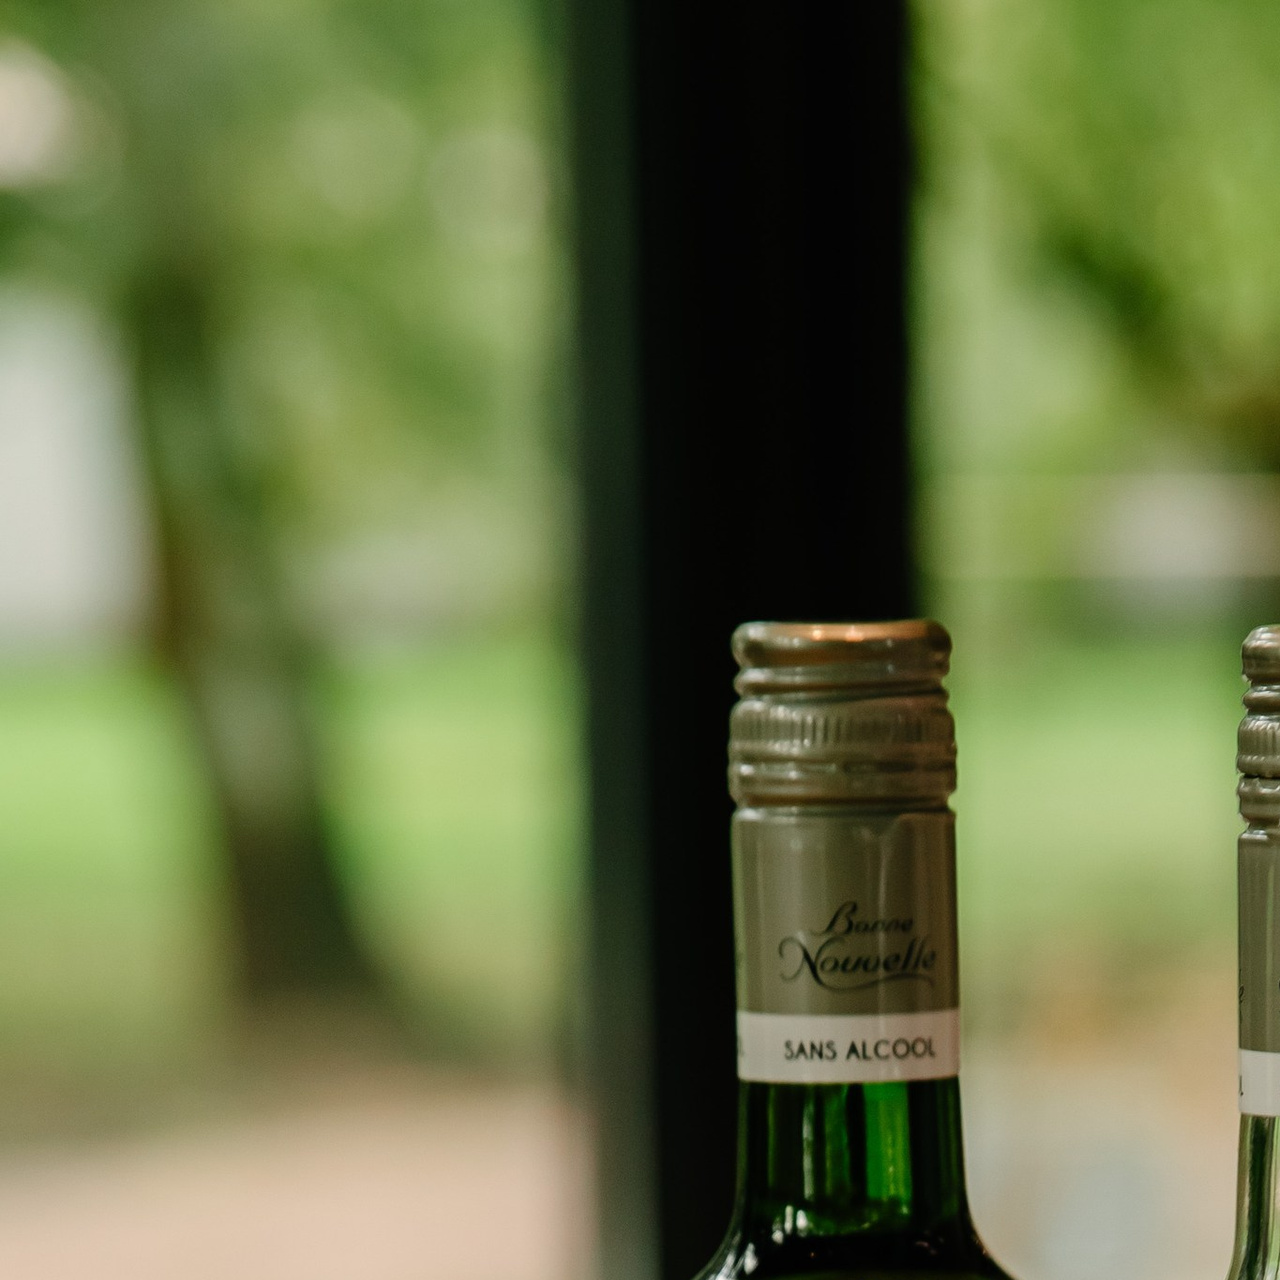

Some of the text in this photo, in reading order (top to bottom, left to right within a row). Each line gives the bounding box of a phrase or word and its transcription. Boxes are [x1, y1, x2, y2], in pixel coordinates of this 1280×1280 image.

[809, 901, 913, 936] Bonne
[778, 936, 937, 993] Nouvelle
[784, 1038, 936, 1061] SANS ALCOOL
